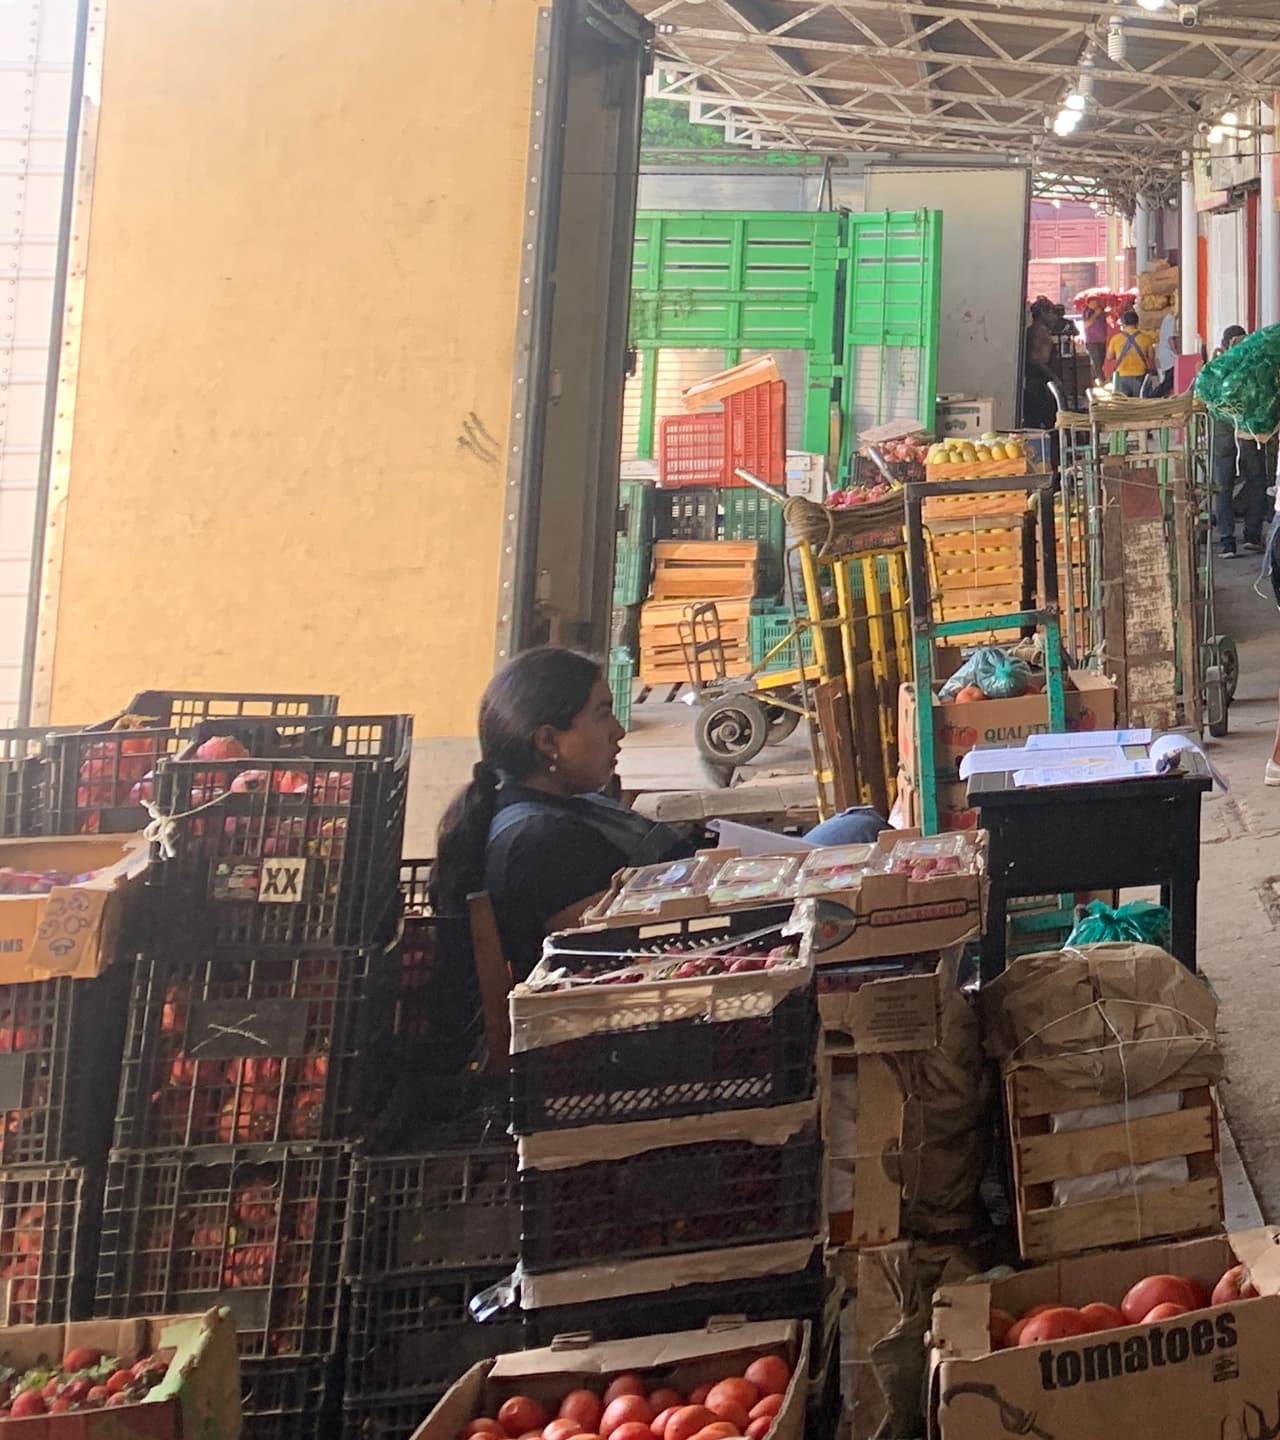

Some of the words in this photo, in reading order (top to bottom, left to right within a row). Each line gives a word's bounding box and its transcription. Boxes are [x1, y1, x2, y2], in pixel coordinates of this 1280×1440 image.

[262, 867, 301, 896] XX
[0, 938, 24, 953] MS
[1038, 1310, 1238, 1392] tomatoes
